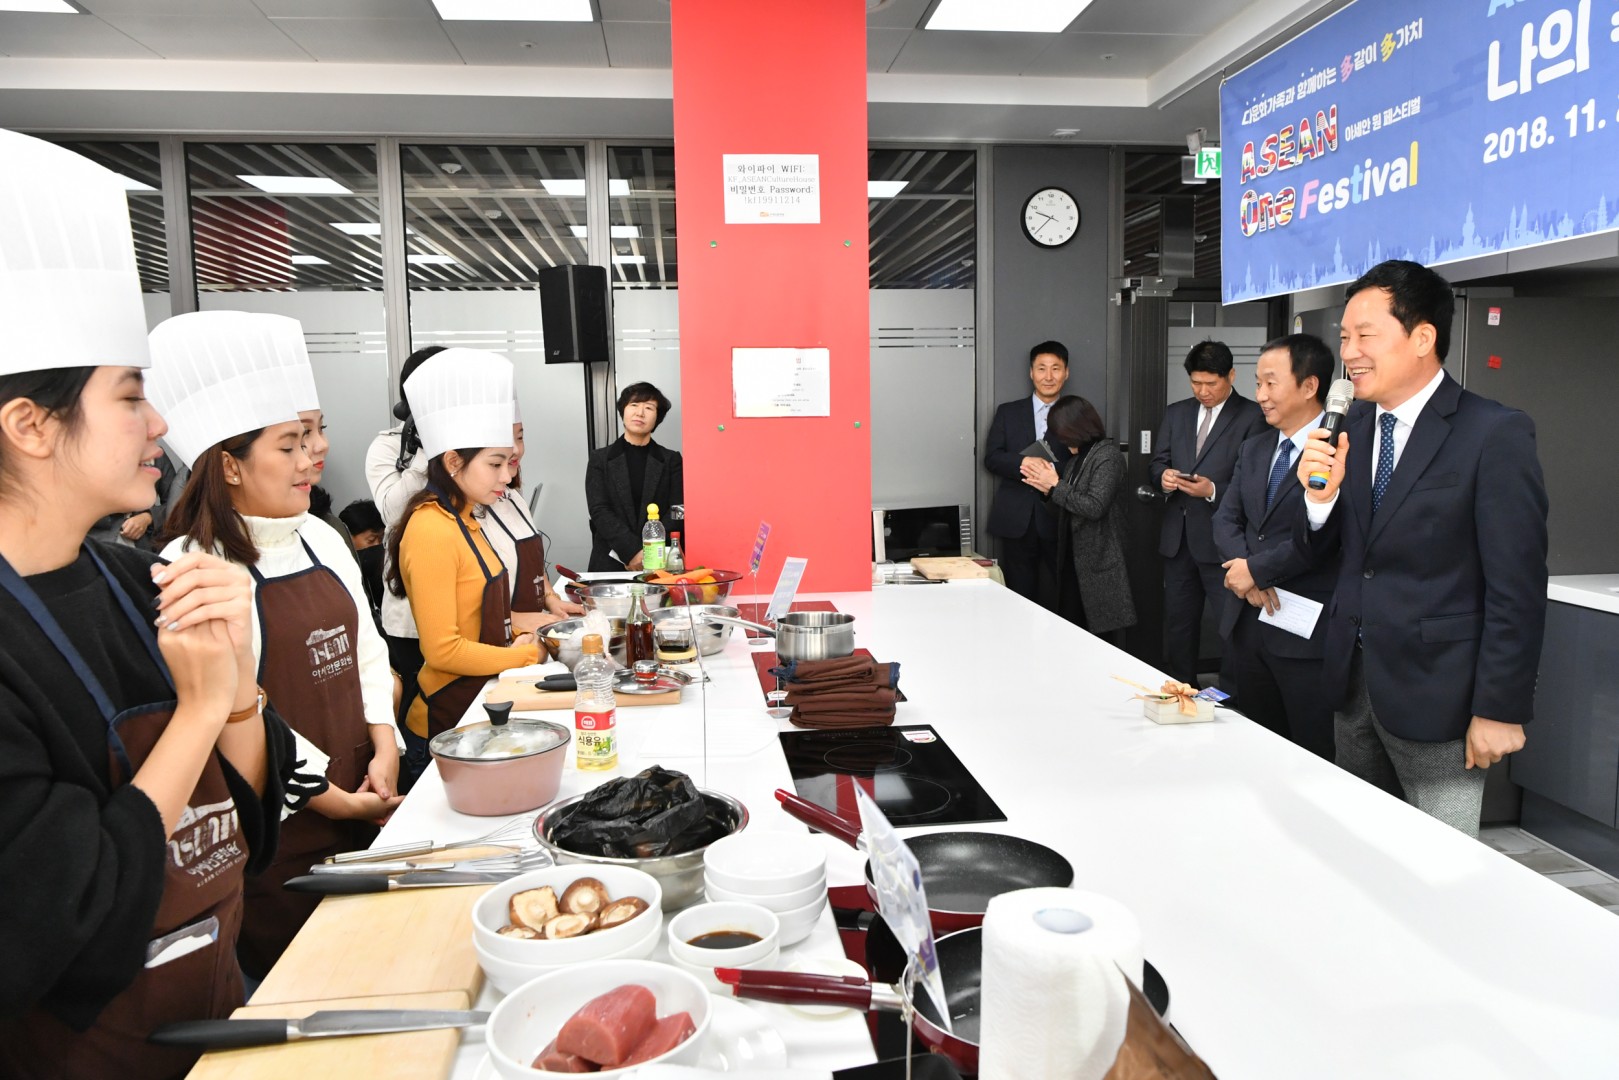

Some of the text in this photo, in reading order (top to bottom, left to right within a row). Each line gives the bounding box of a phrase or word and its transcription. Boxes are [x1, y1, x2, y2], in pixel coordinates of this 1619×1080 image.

[1487, 0, 1591, 101] 나의
[1241, 86, 1296, 125] 다문화가족과
[1297, 66, 1336, 100] 함께하는
[1345, 117, 1371, 142] 아세안
[1383, 96, 1421, 126] 페스티벌
[1240, 104, 1338, 185] ASEAN
[1483, 115, 1555, 164] 2018.
[1564, 98, 1606, 138] 11.
[730, 185, 814, 195] 비밀번호 Password:
[738, 164, 806, 174] 와이파이 WIFI:
[1240, 141, 1419, 237] One Festival
[578, 736, 601, 746] 식용유
